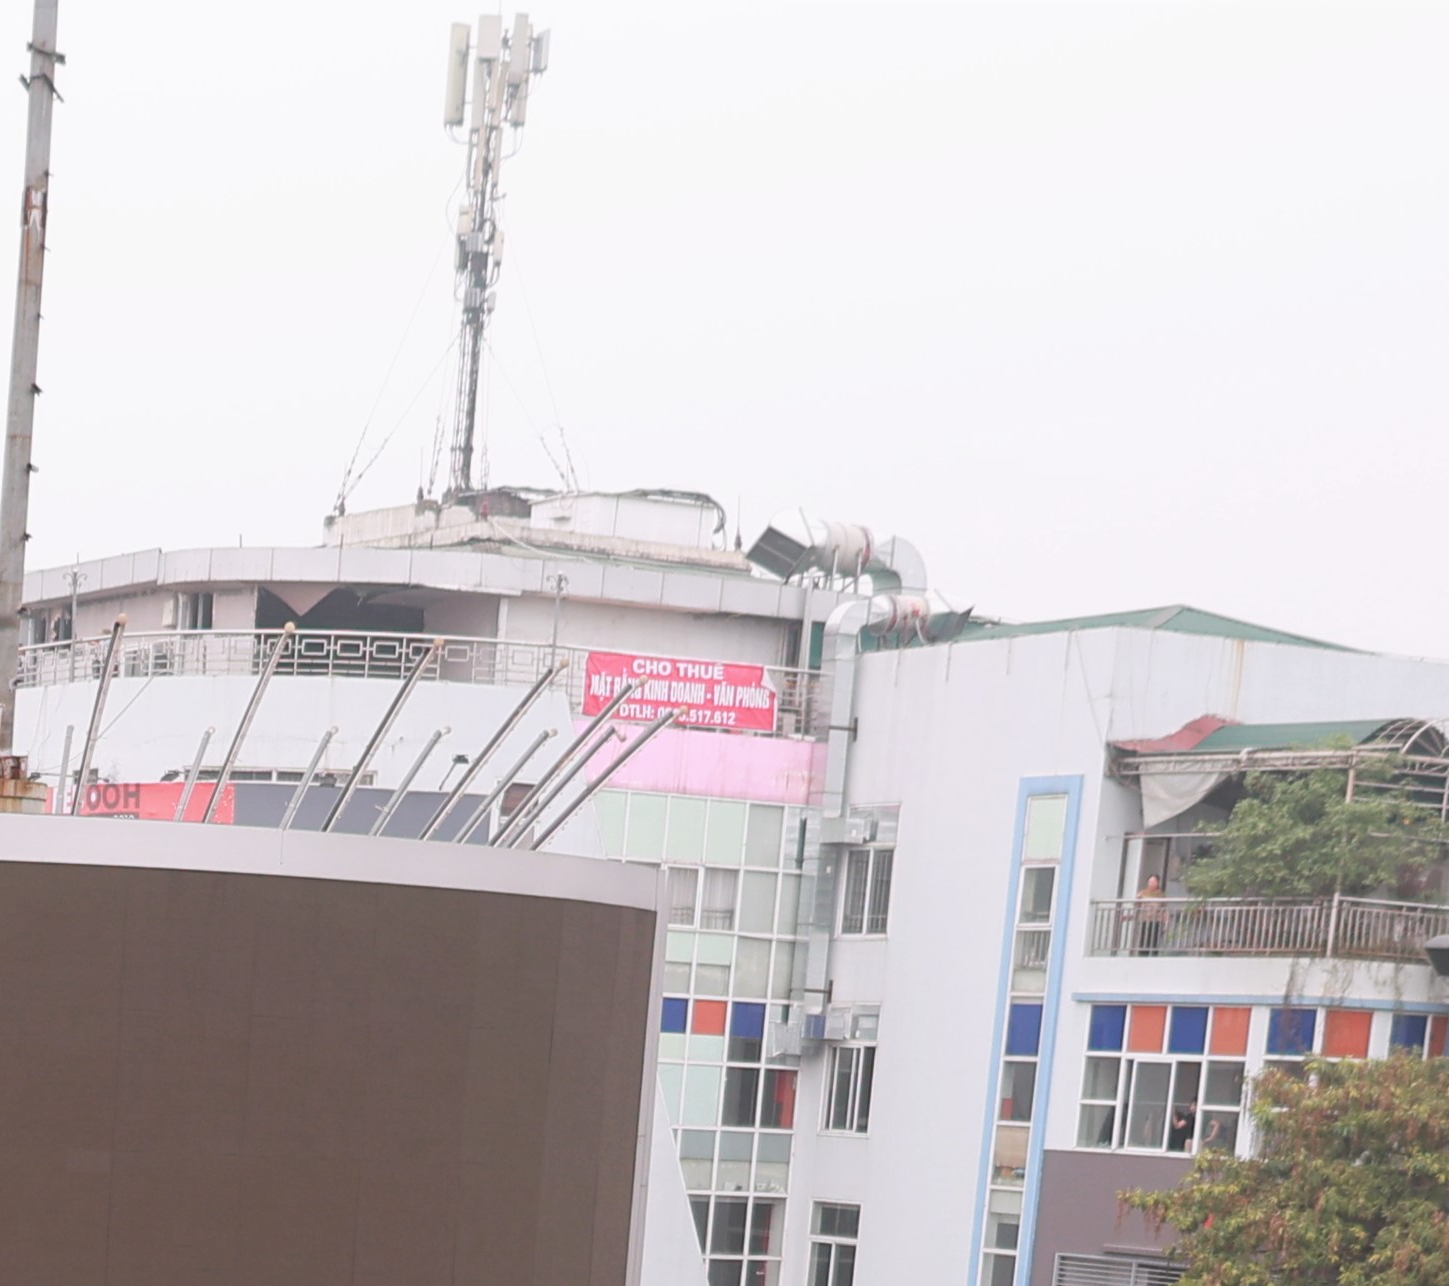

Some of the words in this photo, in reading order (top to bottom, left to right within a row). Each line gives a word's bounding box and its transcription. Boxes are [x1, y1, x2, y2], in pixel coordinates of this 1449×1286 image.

[632, 658, 672, 676] CHO
[675, 662, 725, 681] THUÊ
[643, 680, 670, 702] KINH
[670, 680, 705, 707] DOANH
[713, 682, 734, 707] VĂN
[734, 682, 771, 709] PHÒNG
